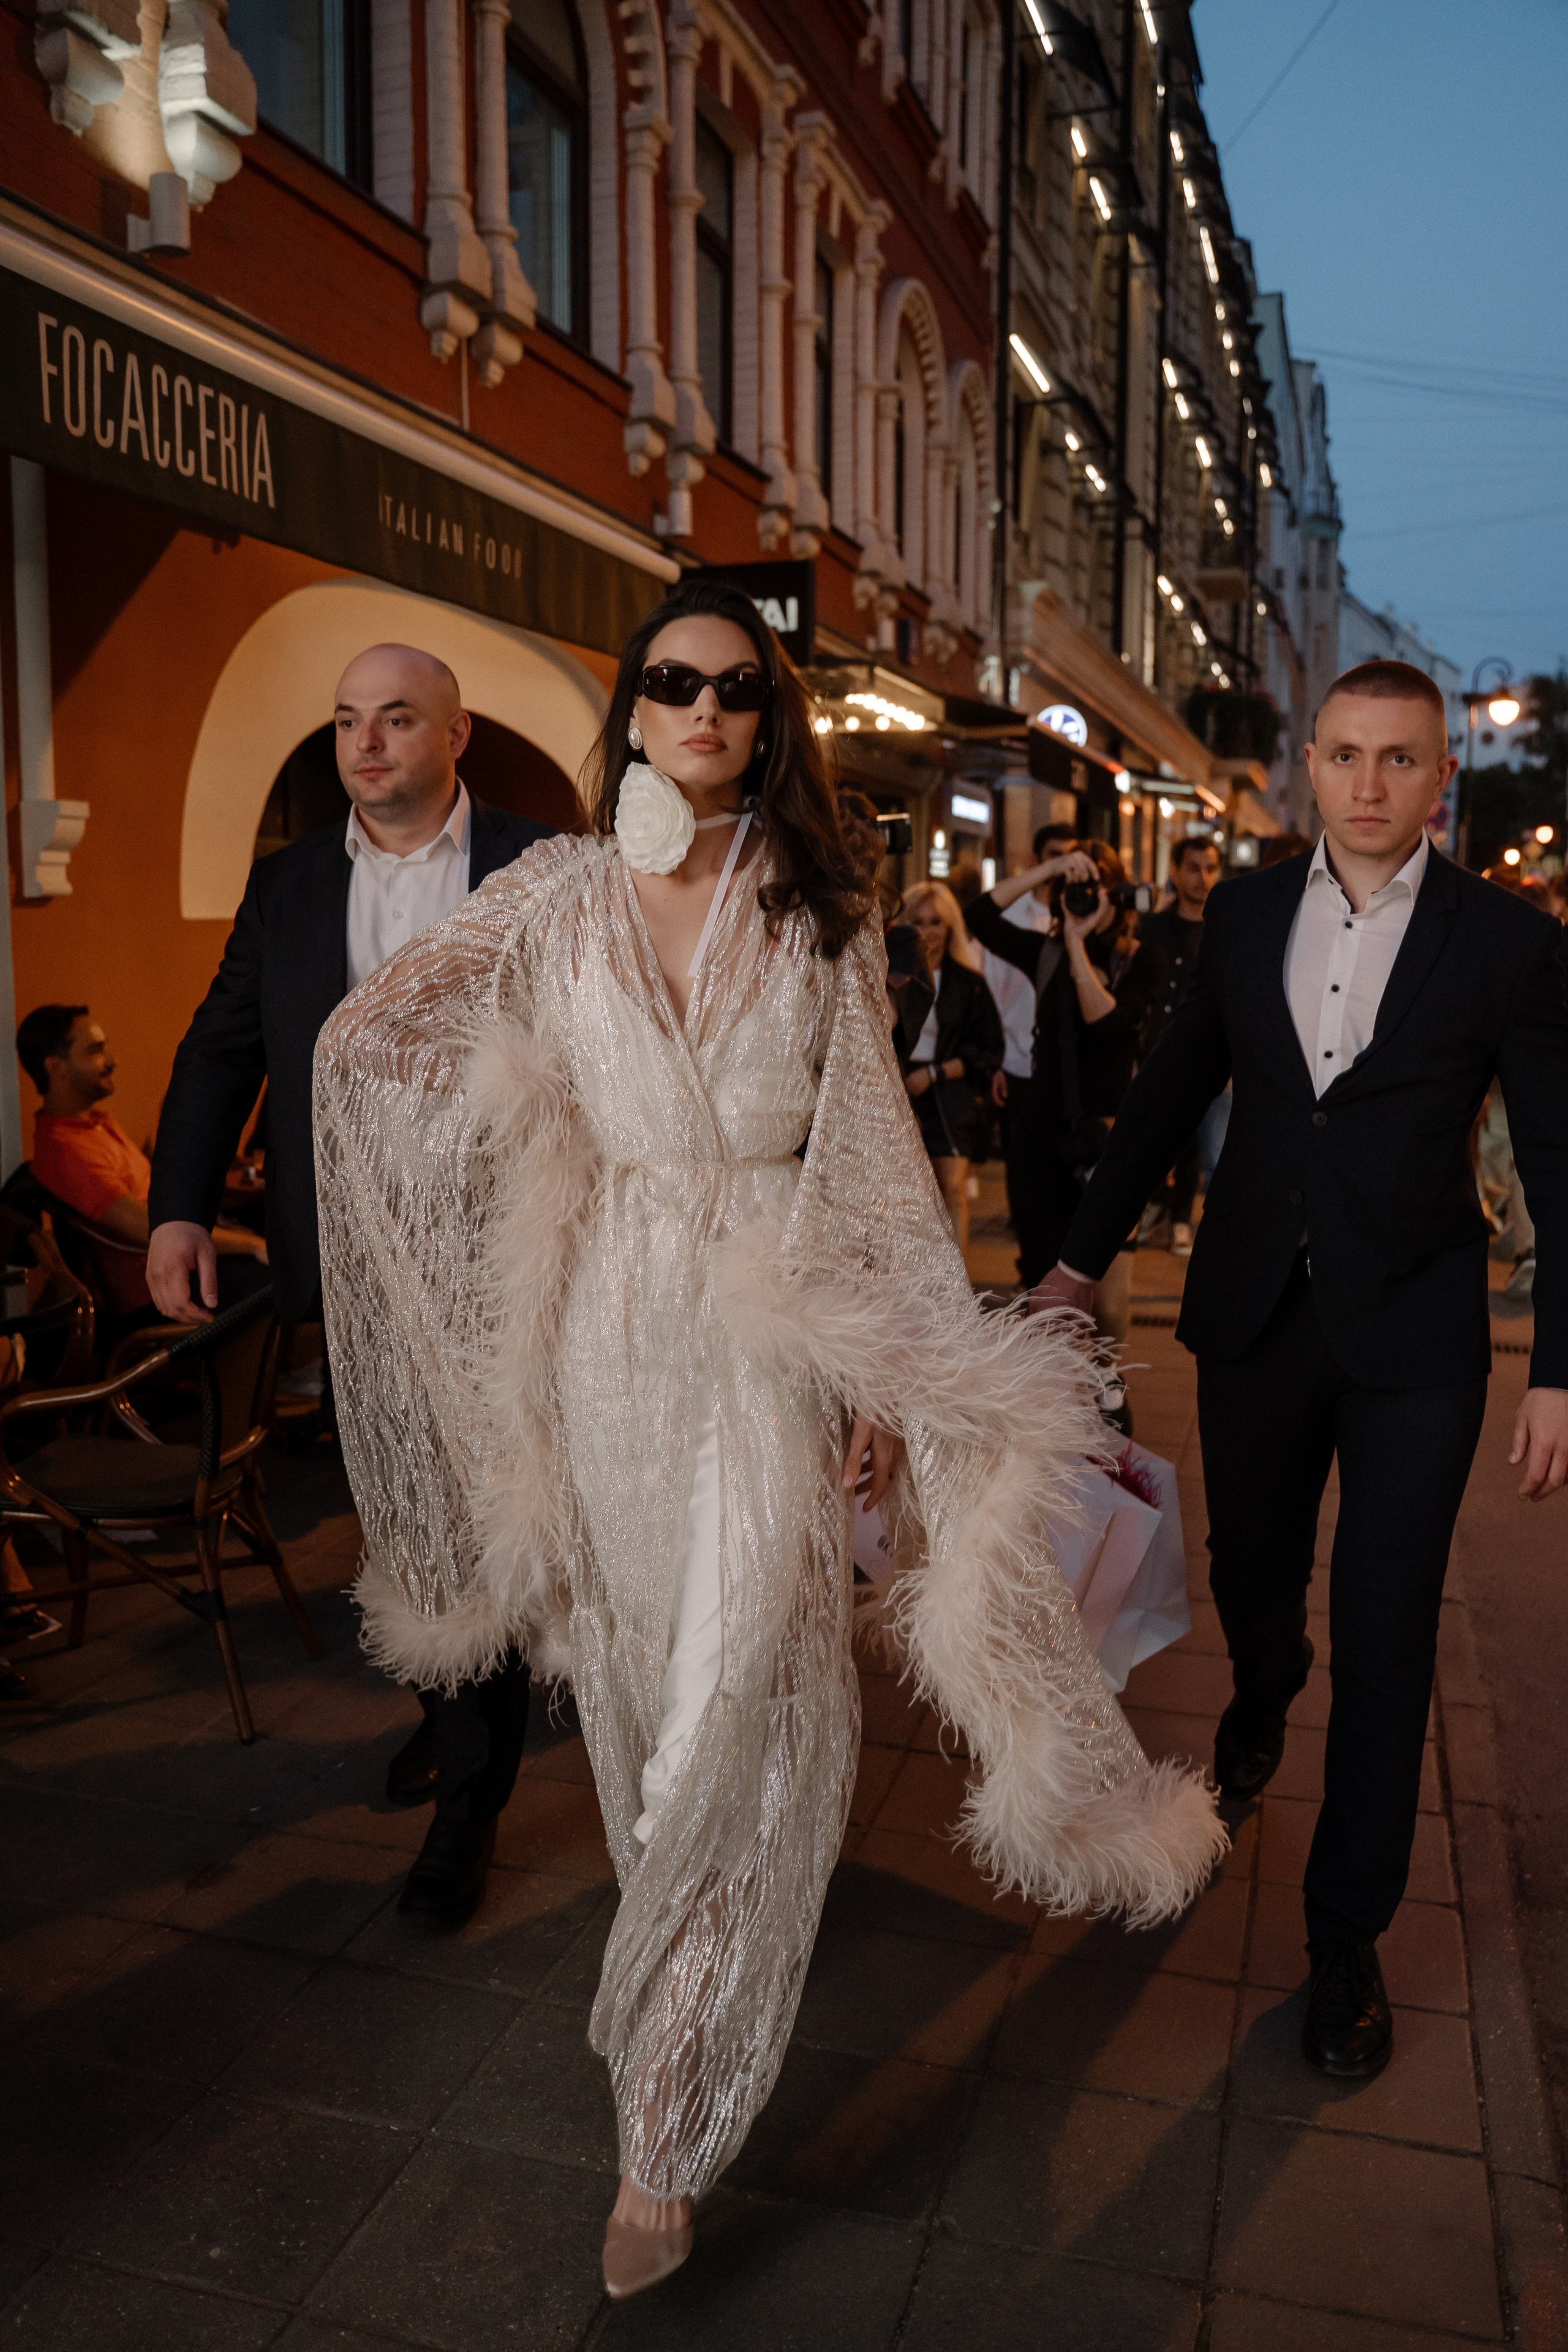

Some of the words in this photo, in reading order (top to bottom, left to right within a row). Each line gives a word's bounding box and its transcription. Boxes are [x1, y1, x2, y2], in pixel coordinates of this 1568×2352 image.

[37, 311, 276, 508] FOCACCERIA
[379, 494, 464, 556] ITALIAN
[752, 597, 798, 632] AI
